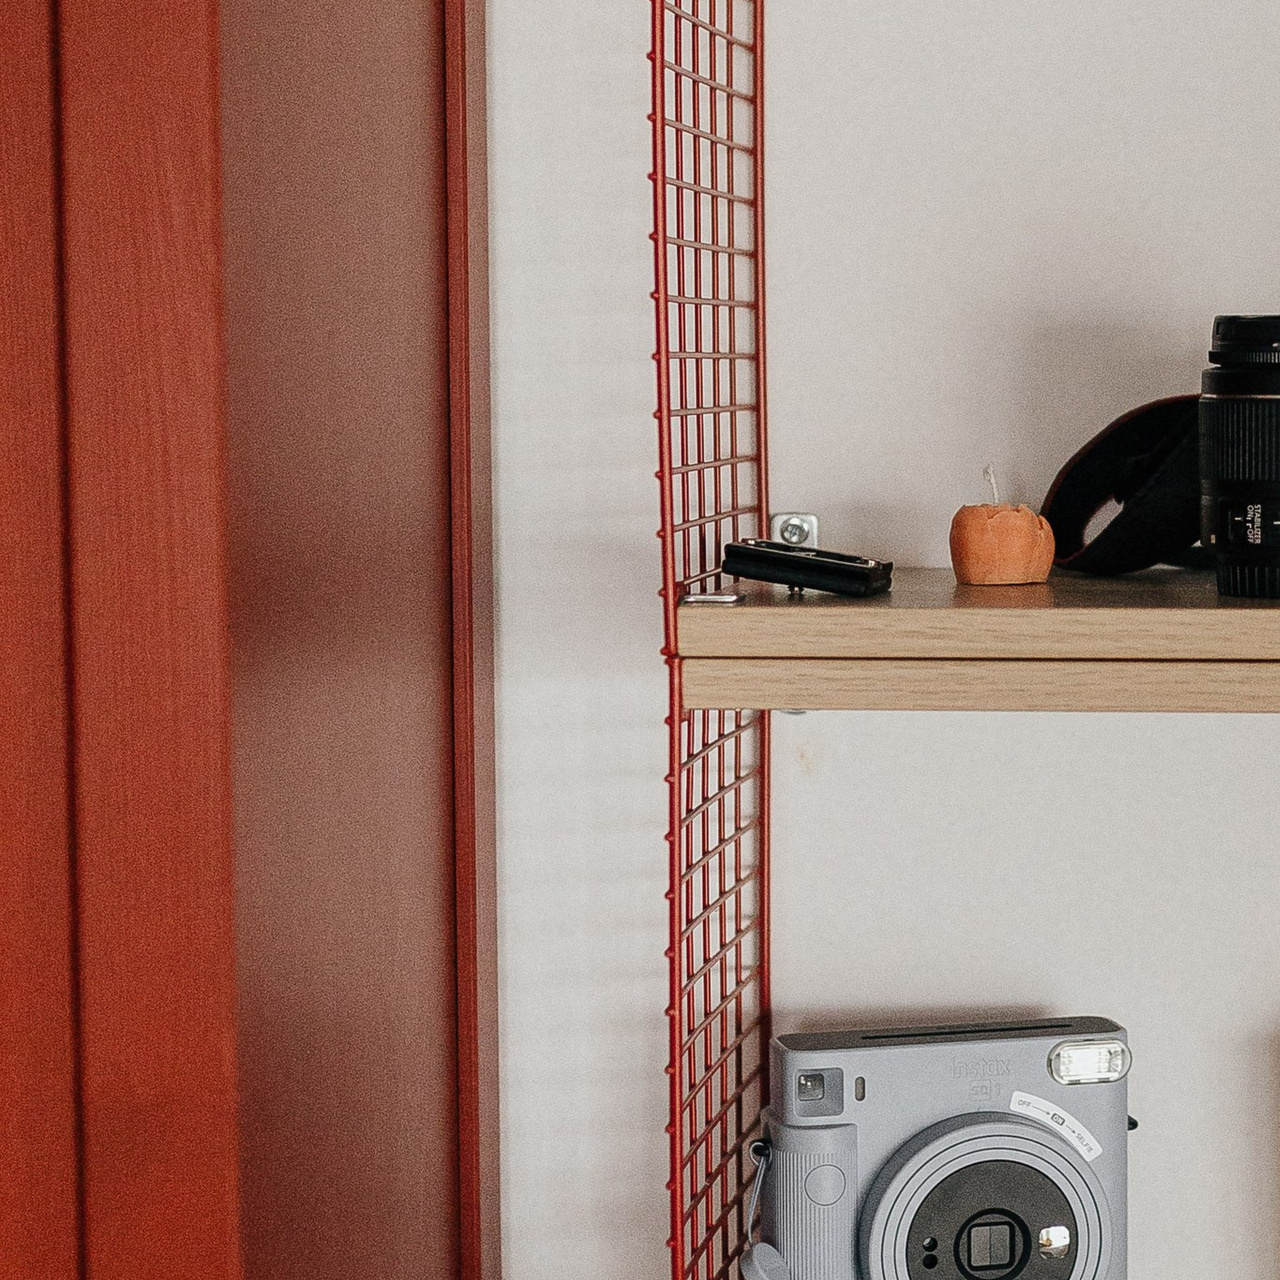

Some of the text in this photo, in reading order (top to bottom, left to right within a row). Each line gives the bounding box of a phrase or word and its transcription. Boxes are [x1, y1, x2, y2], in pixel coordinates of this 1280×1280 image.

[1246, 504, 1254, 544] ON OFF
[1253, 503, 1262, 545] STABILIZER
[1017, 1099, 1032, 1108] OFF
